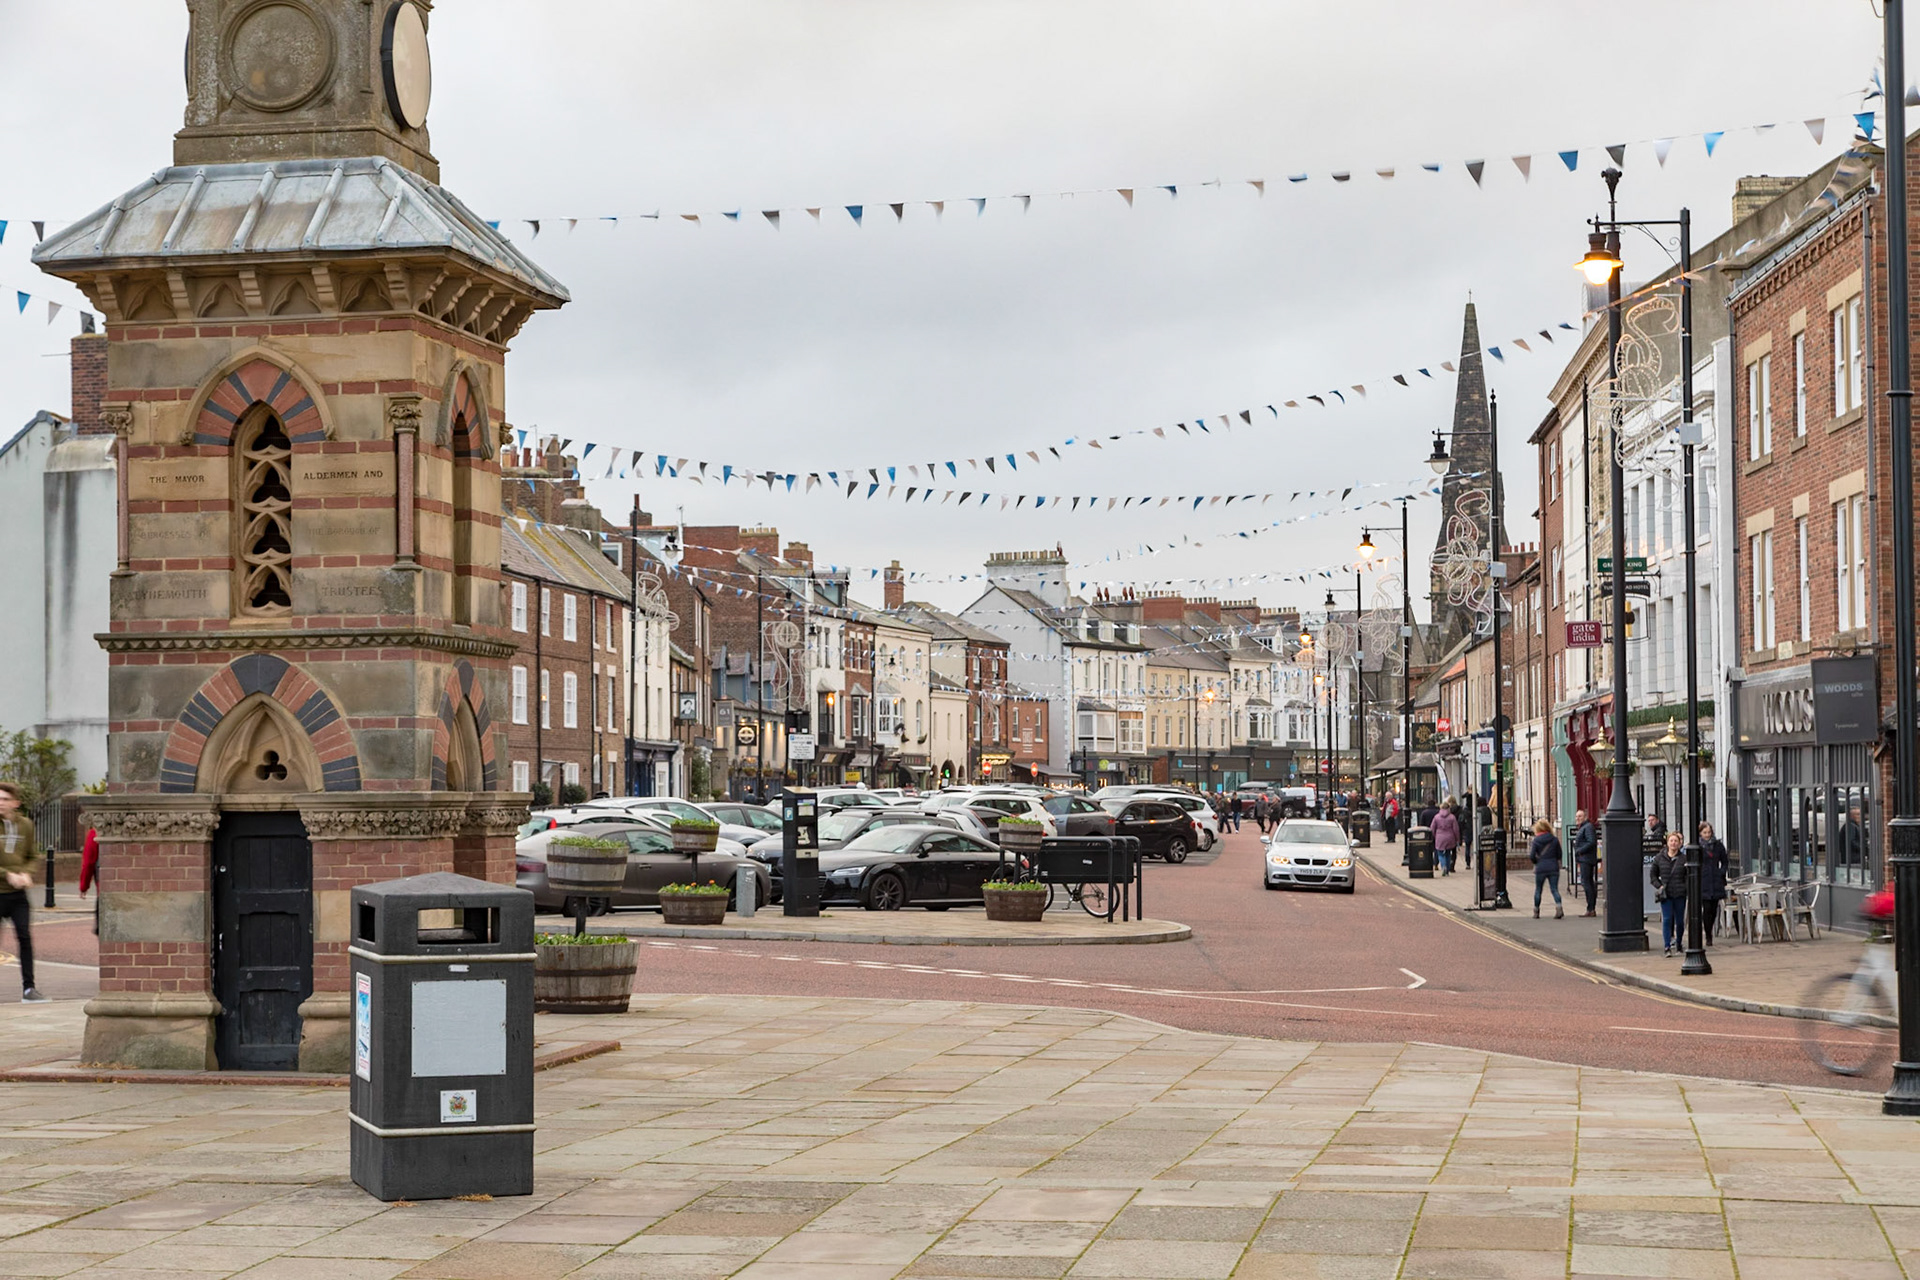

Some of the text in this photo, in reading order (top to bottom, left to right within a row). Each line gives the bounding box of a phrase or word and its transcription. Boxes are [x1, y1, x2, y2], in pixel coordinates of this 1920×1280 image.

[148, 475, 205, 484] THE MAYOR
[303, 470, 384, 480] ALDERMEN AND
[321, 585, 384, 597] TRUSTEES
[1572, 624, 1595, 634] gate
[1573, 632, 1595, 642] india
[1824, 683, 1863, 693] WOODS
[1762, 687, 1815, 734] WOODS
